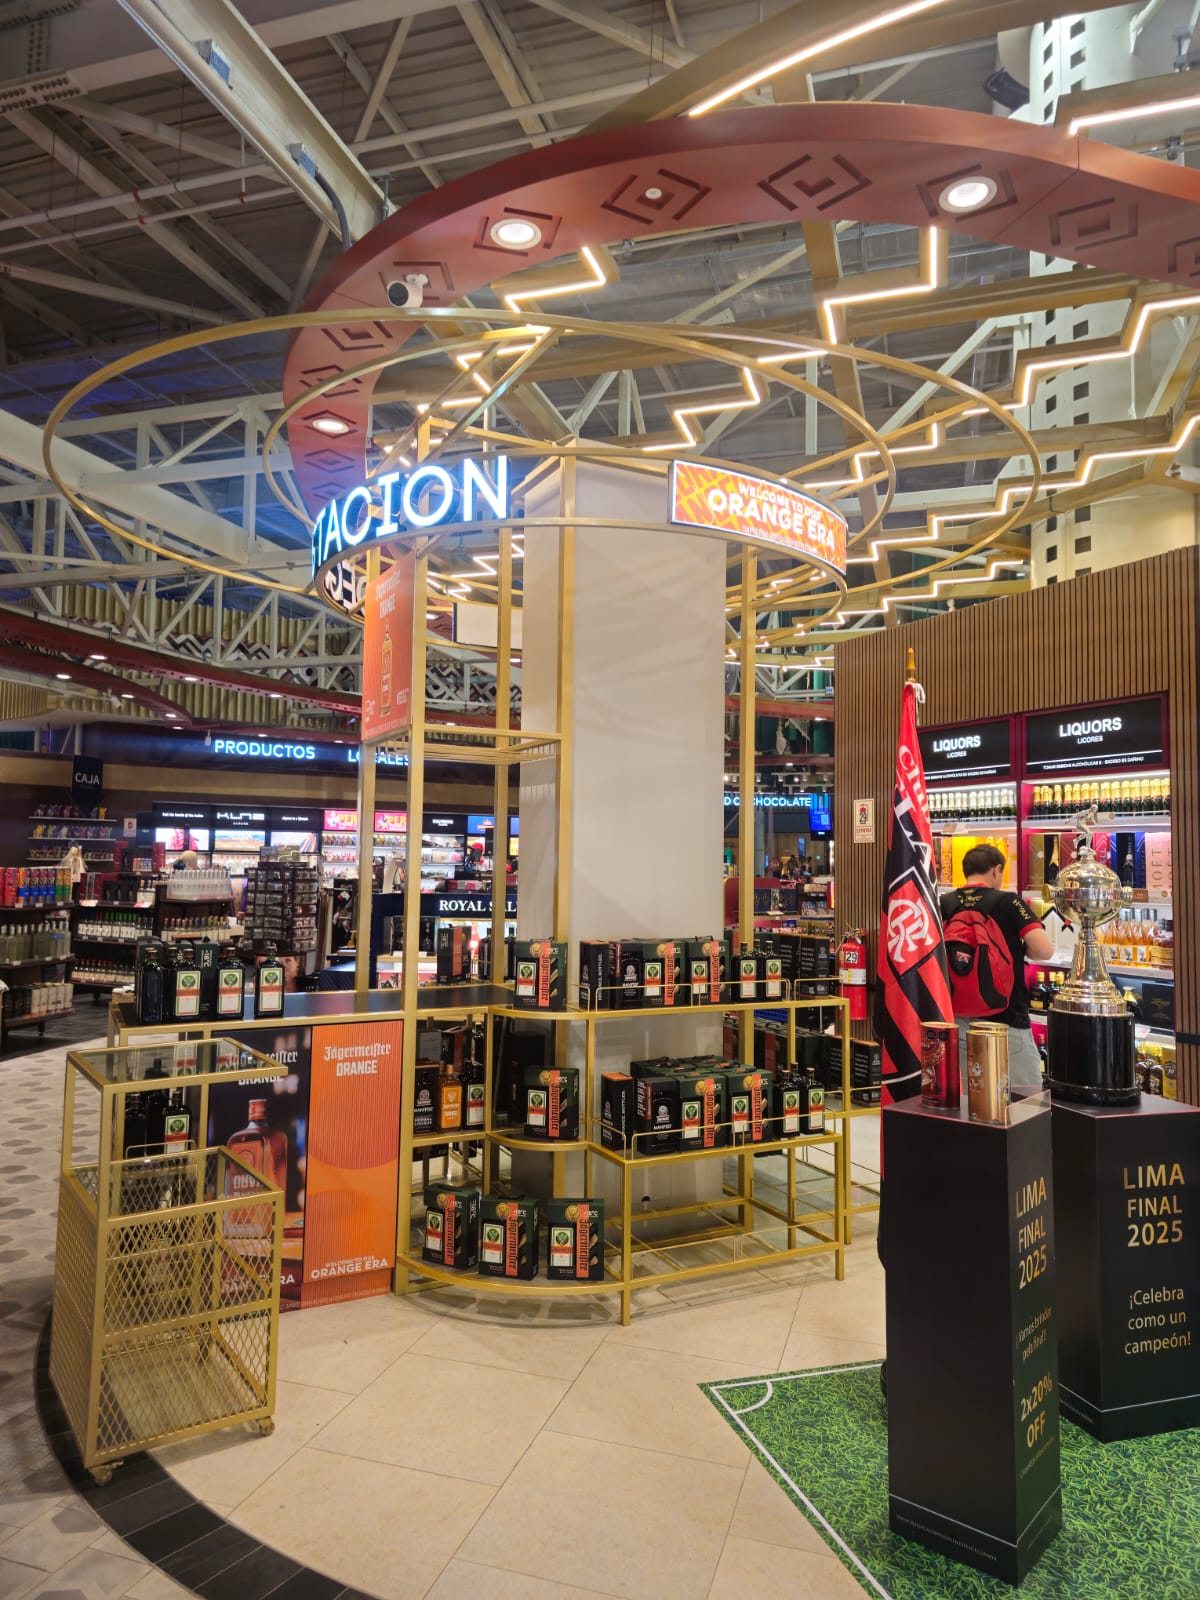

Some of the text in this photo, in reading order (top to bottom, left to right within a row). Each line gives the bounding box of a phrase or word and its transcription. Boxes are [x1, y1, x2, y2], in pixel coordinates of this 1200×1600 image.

[738, 483, 820, 521] WELCOME TO OUR
[708, 489, 803, 533] ORANGE
[808, 521, 835, 550] ERA
[1058, 717, 1123, 737] LIQUORS
[214, 739, 316, 760] PRODUCTOS
[933, 735, 981, 752] LIQUORS
[1077, 735, 1104, 744] LICORES
[75, 772, 100, 785] CAJA
[439, 900, 486, 911] ROYAL
[846, 952, 857, 963] 29
[336, 1060, 378, 1077] ORANGE
[1123, 1163, 1186, 1190] LIMA
[1015, 1176, 1048, 1219] LIMA
[1127, 1195, 1183, 1219] FINAL
[1018, 1215, 1047, 1255] FINAL
[1127, 1220, 1184, 1248] 2025
[311, 1258, 388, 1279] ORANGE ERA
[1018, 1244, 1048, 1290] 2025
[1129, 1286, 1186, 1311] ¡Celebra
[1128, 1310, 1188, 1331] como un
[1124, 1331, 1192, 1356] campeón!
[1020, 1371, 1053, 1423] 2x20%
[1026, 1410, 1047, 1449] OFF
